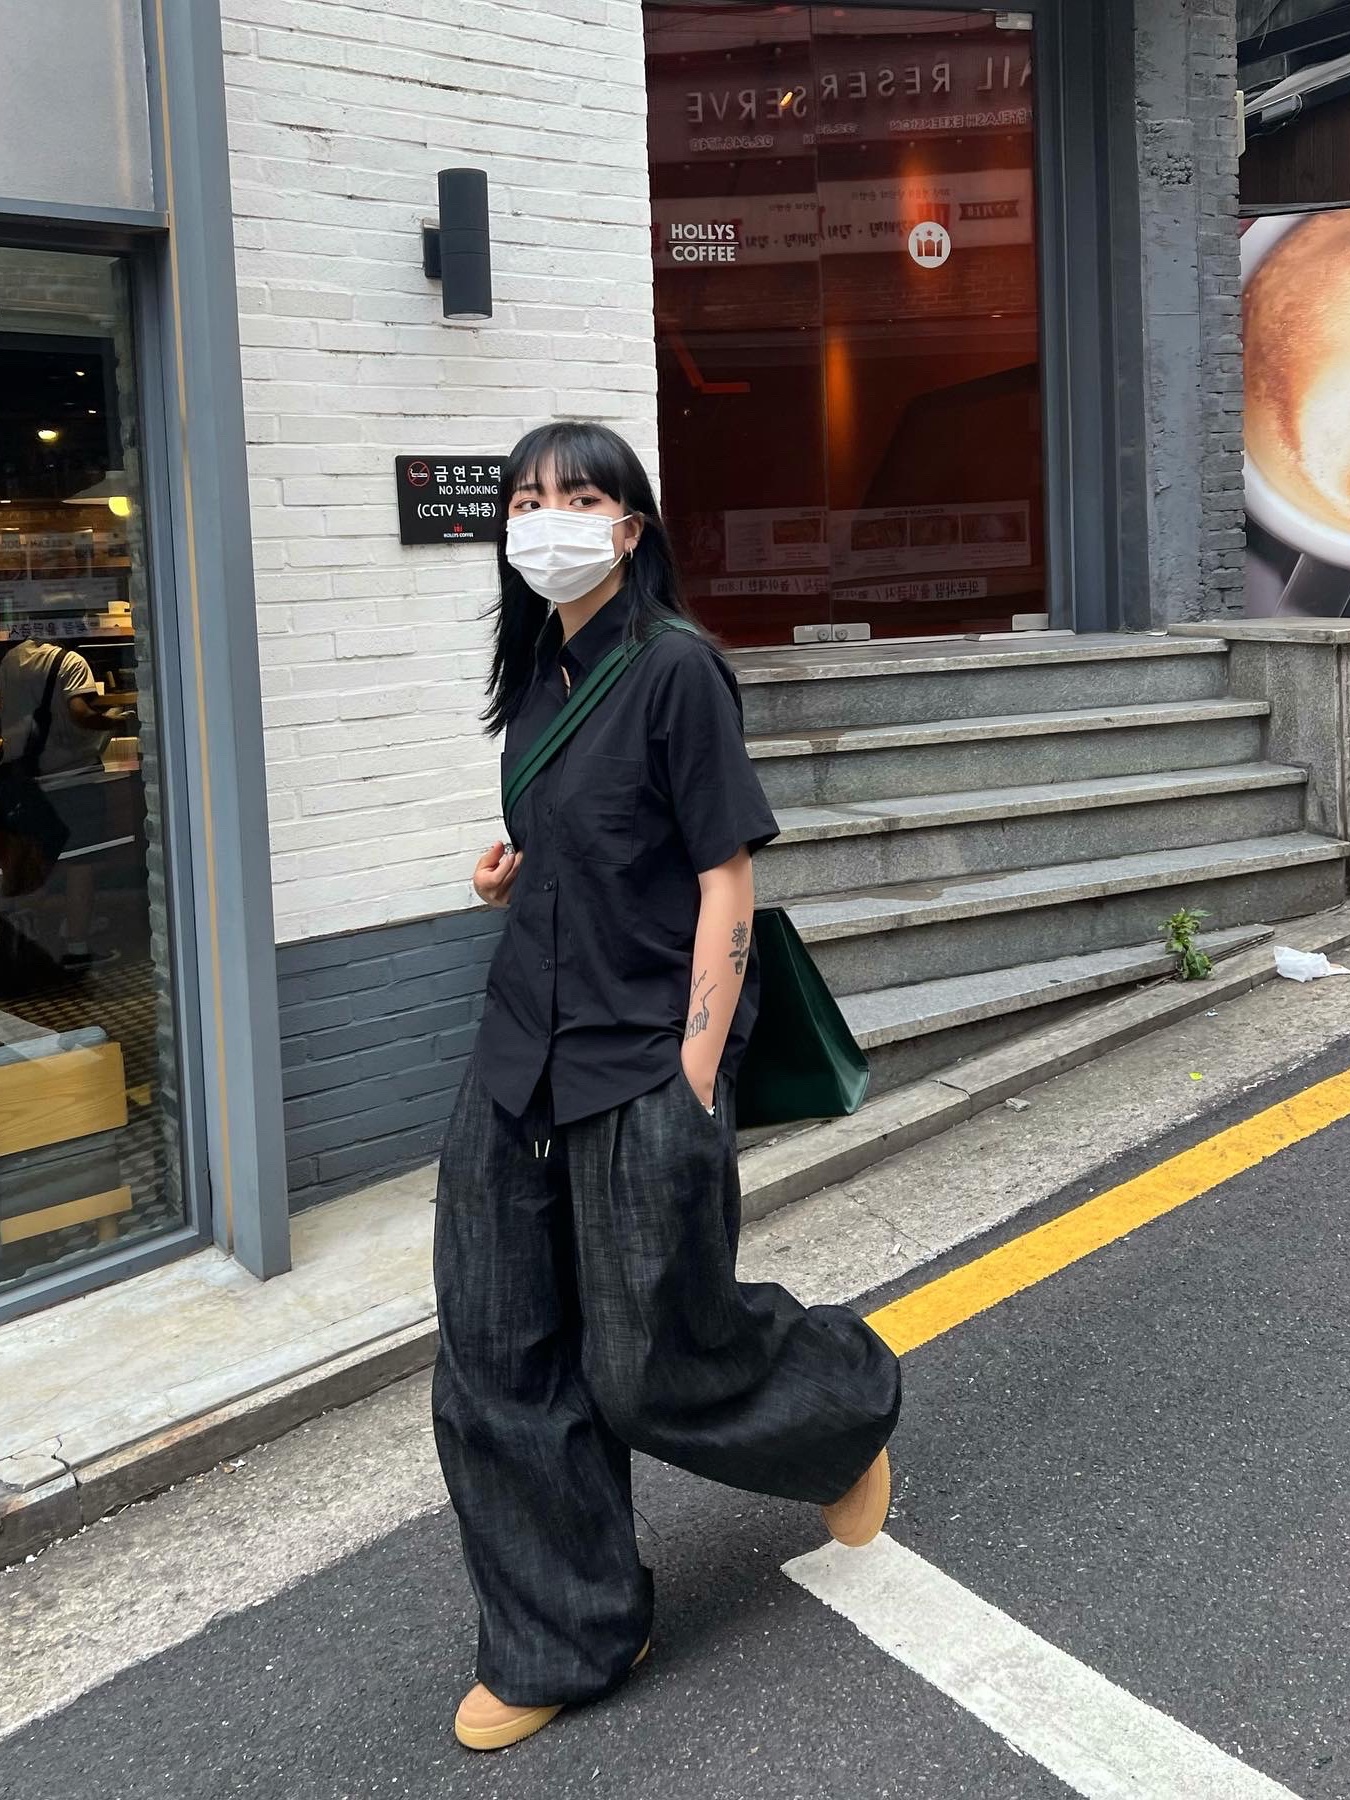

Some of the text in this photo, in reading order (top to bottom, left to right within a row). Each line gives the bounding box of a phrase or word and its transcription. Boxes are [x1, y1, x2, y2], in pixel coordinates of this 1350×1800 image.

[671, 223, 734, 240] HOLLYS
[672, 245, 736, 263] COFFEE
[438, 485, 498, 495] NO SMOKING
[417, 502, 496, 519] (CCTV 녹화중)
